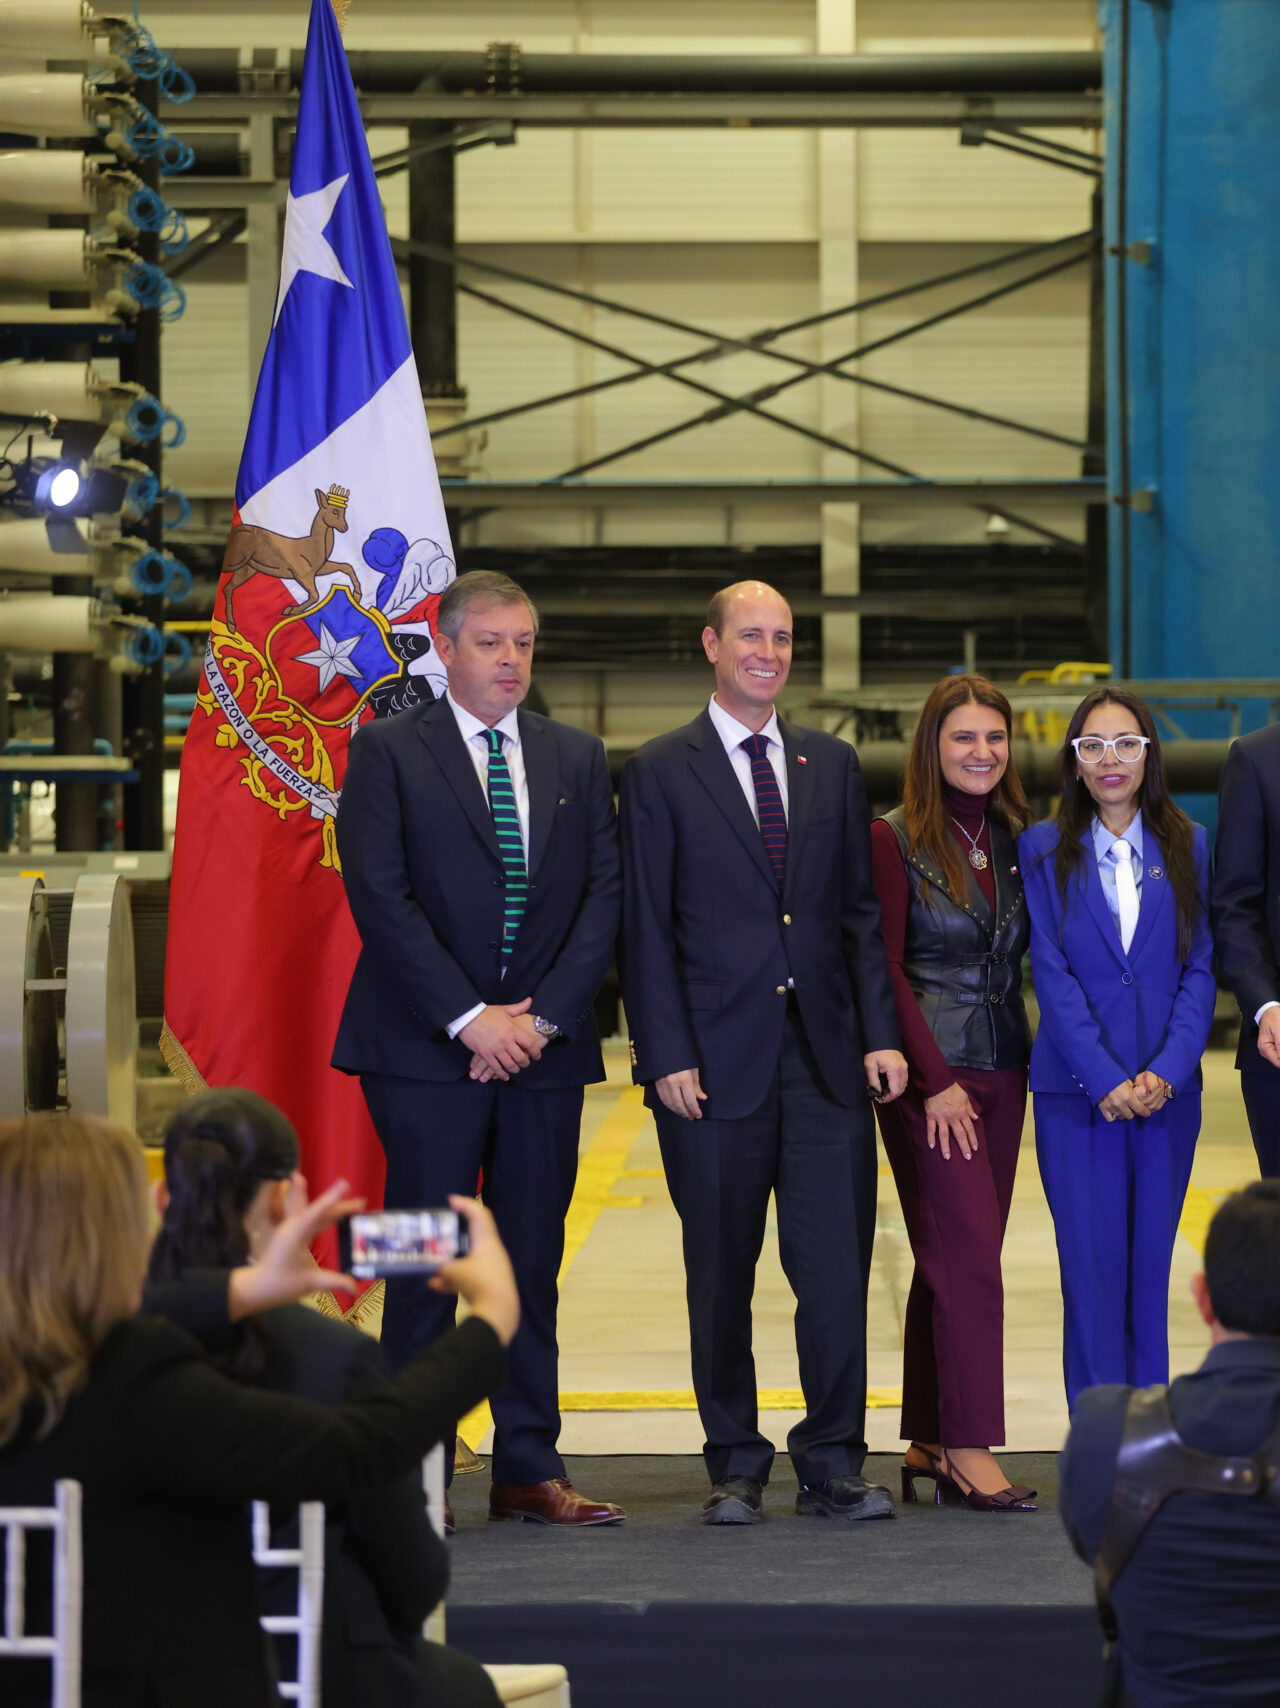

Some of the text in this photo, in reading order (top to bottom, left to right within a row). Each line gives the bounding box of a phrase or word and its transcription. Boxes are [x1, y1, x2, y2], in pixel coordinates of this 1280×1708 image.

[206, 661, 218, 680] LA
[213, 683, 245, 728] RAZON
[243, 729, 254, 739] O
[252, 740, 269, 759] LA
[269, 758, 315, 798] FUERZA
